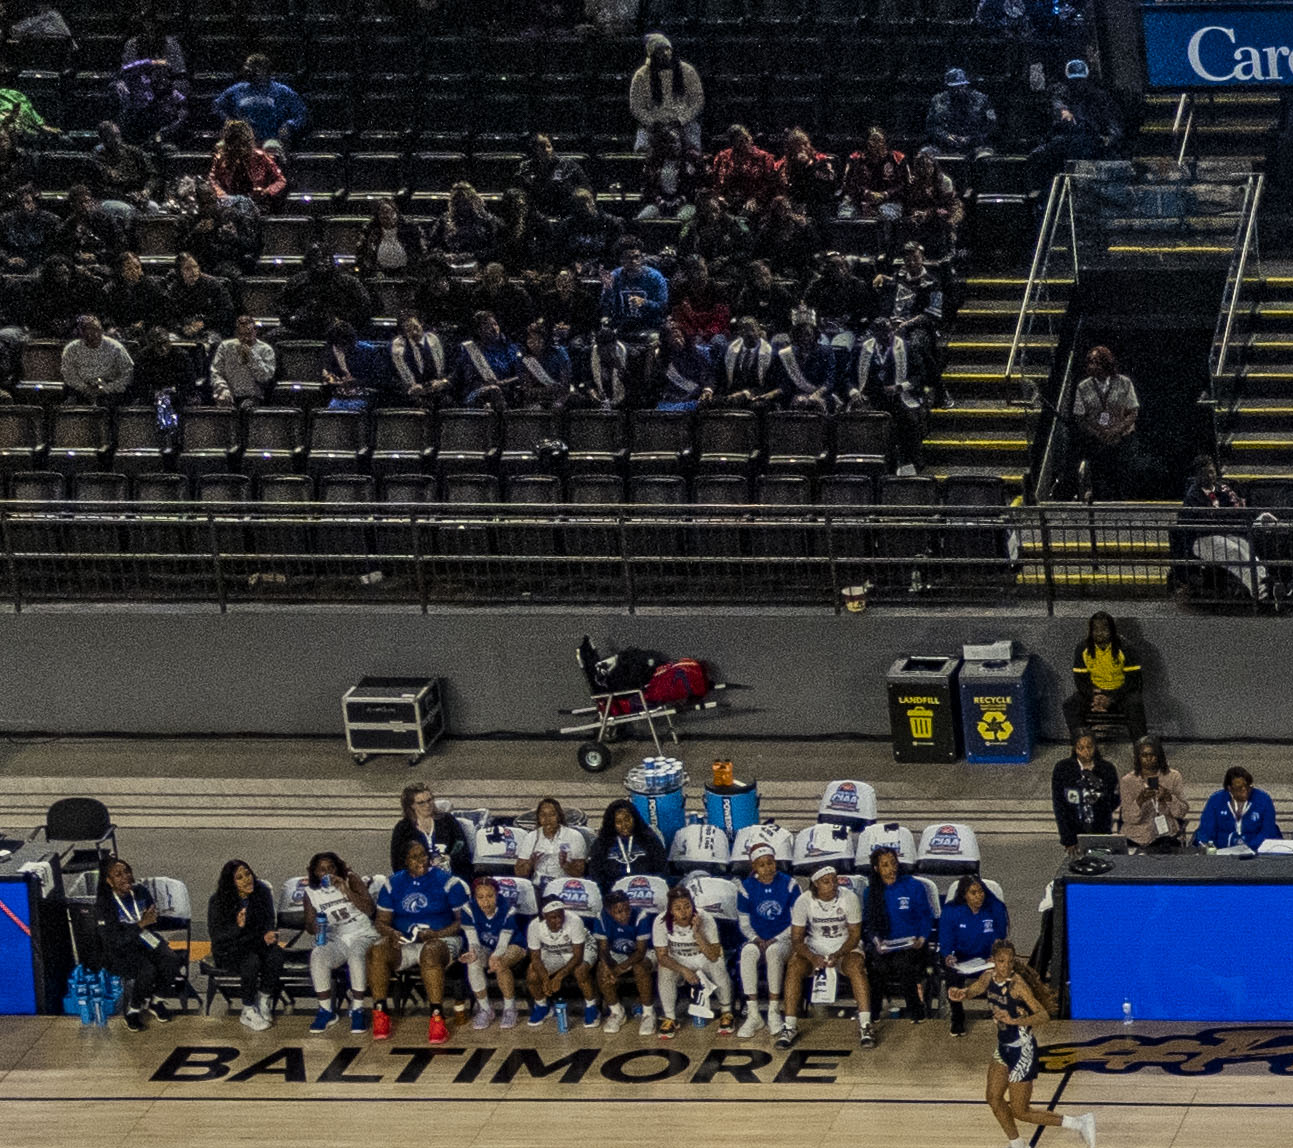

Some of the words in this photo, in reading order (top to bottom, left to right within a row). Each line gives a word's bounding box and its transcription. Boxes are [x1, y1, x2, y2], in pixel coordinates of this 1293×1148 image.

[898, 696, 941, 705] LANDFILL
[973, 696, 1012, 705] RECYCLE
[148, 1045, 853, 1085] BALTIMORE
